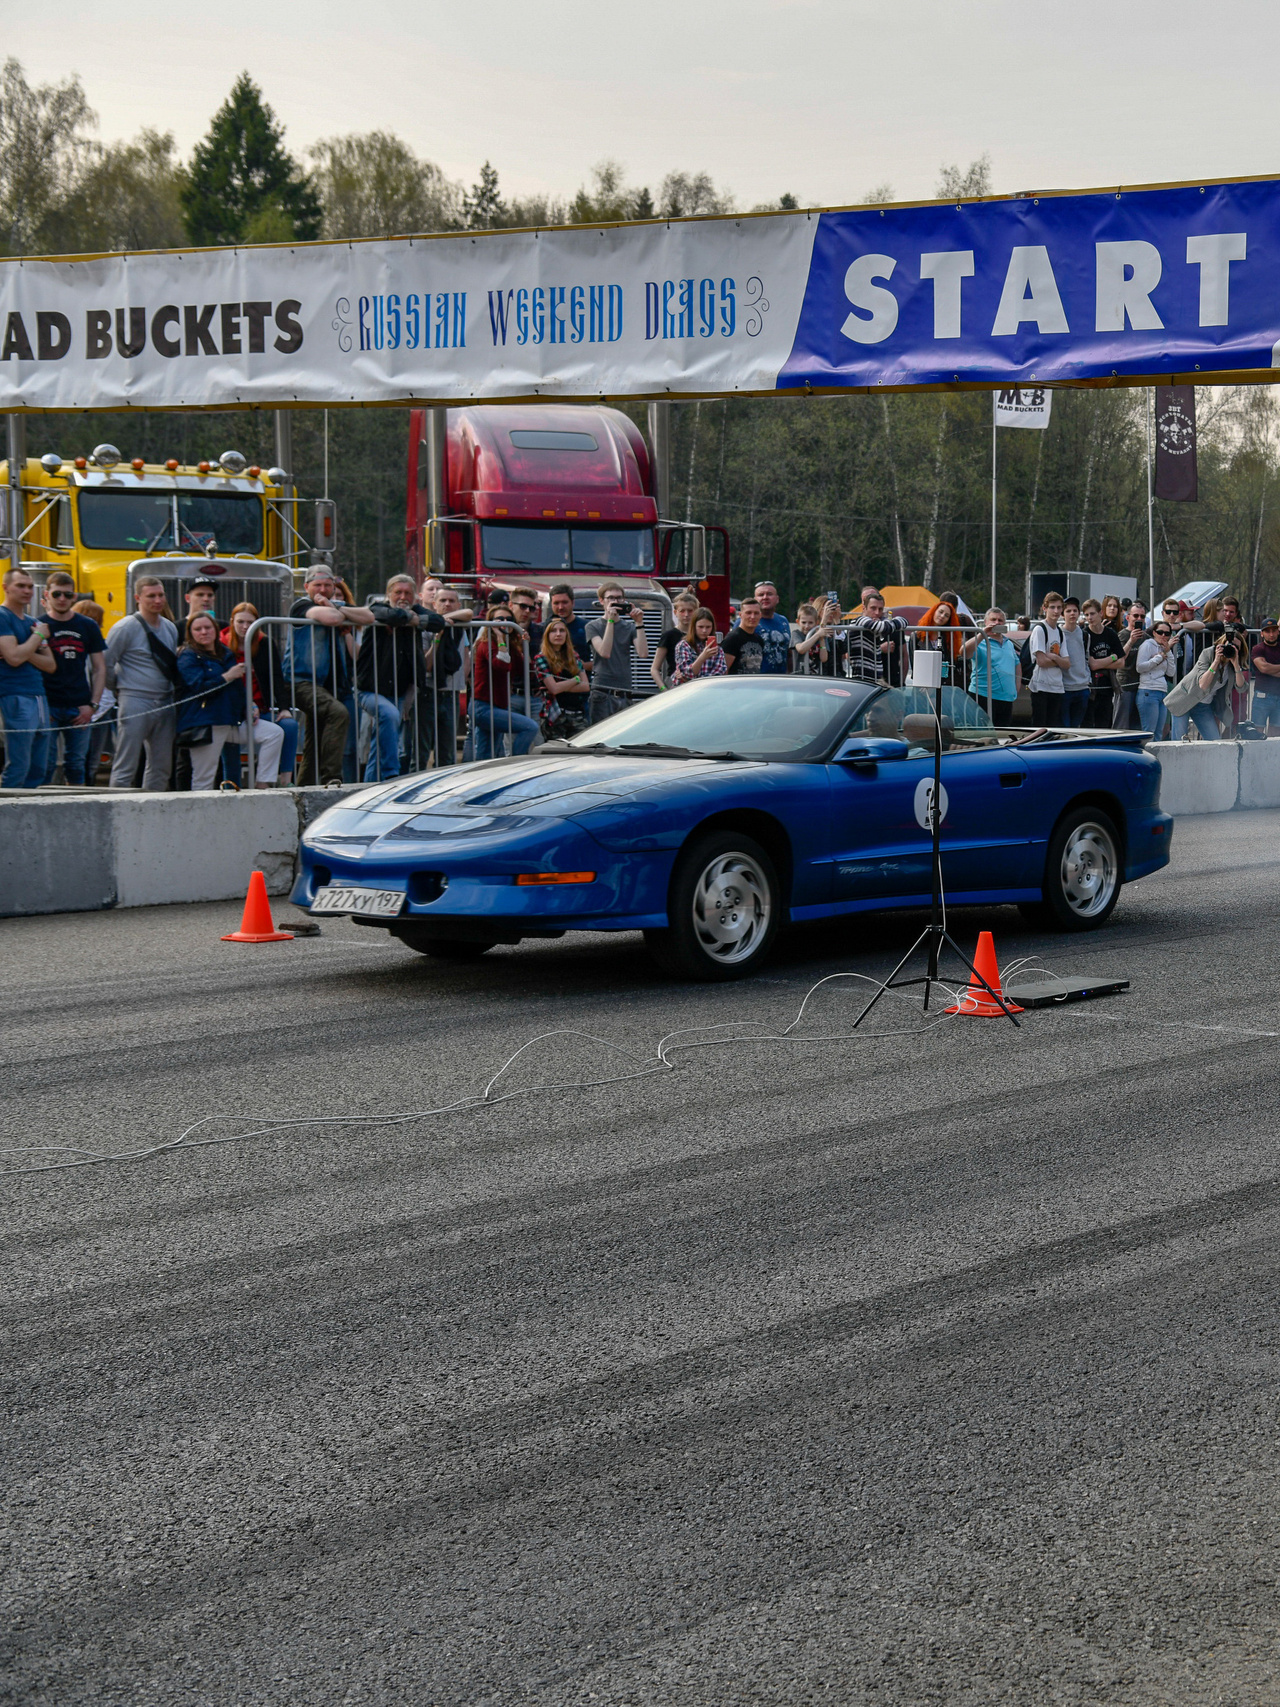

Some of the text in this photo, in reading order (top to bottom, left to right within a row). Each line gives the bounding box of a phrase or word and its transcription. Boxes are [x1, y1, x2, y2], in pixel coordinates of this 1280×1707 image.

[840, 232, 1247, 344] START
[86, 299, 304, 359] BUCKETS
[376, 892, 402, 907] 197
